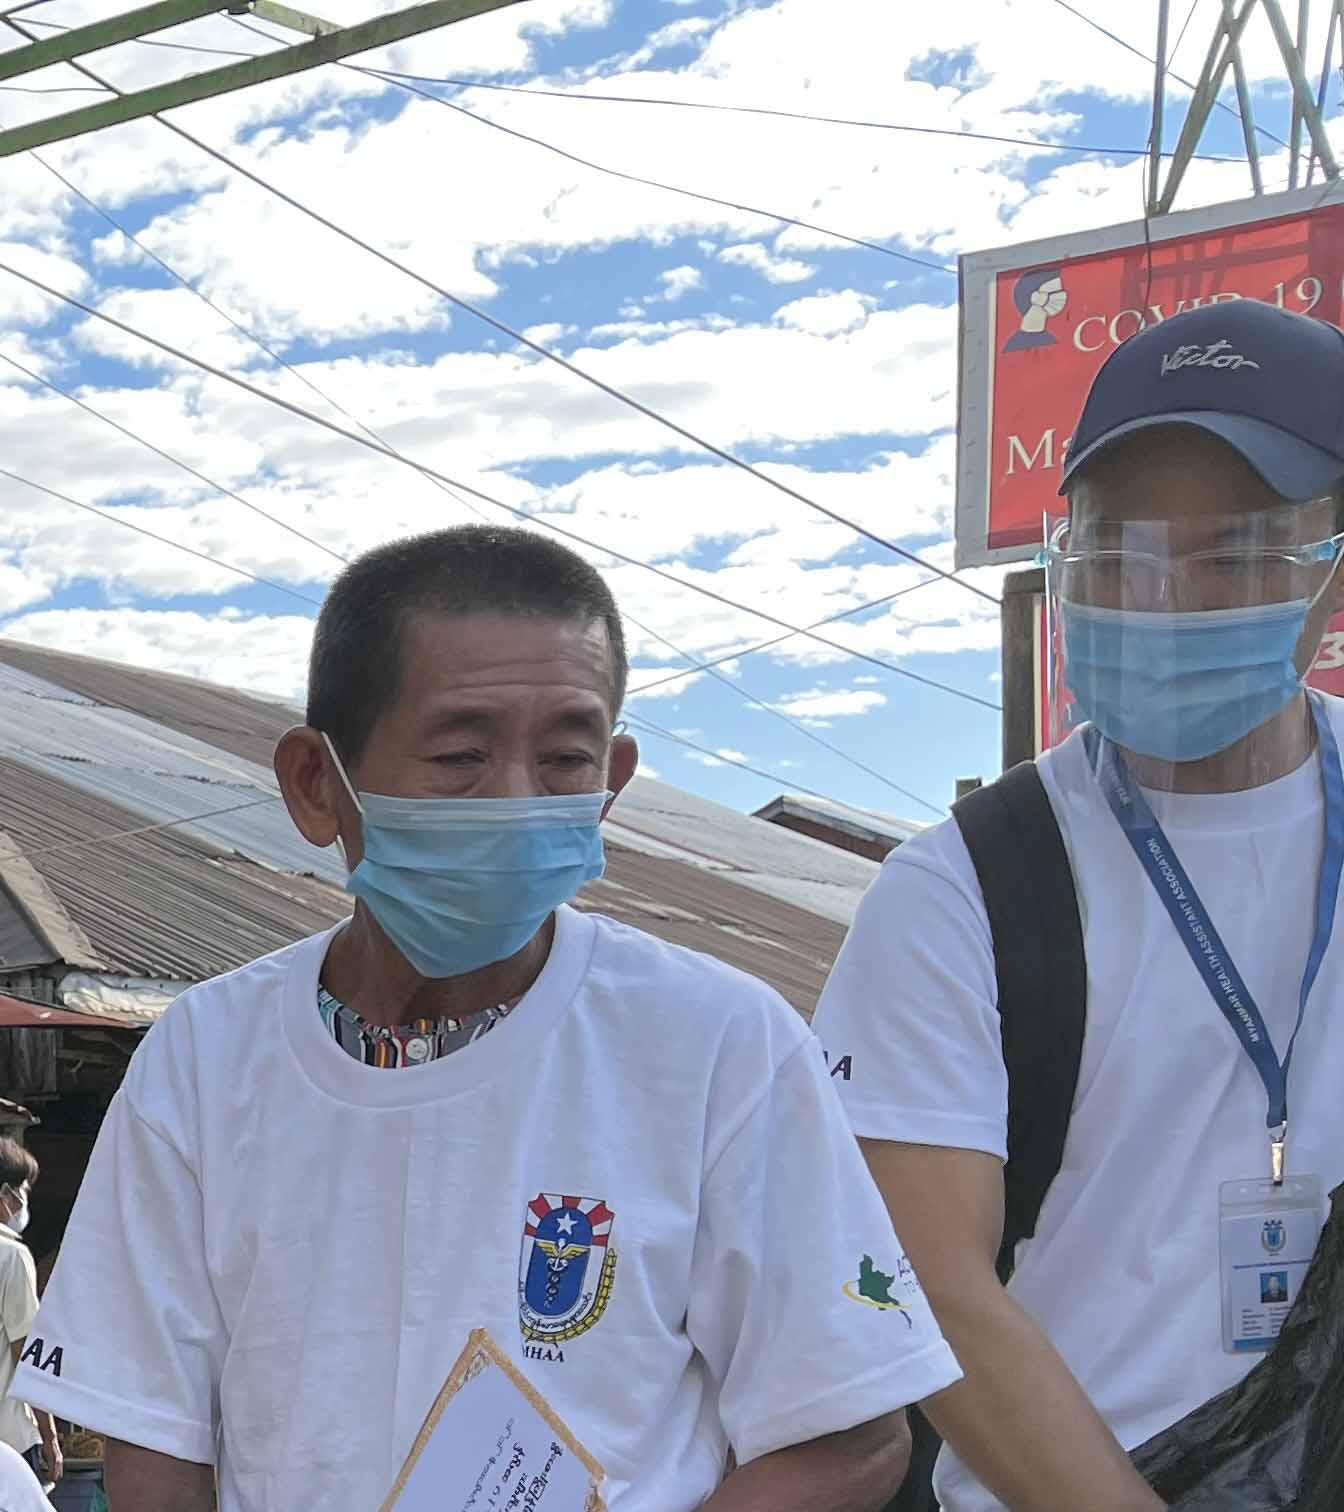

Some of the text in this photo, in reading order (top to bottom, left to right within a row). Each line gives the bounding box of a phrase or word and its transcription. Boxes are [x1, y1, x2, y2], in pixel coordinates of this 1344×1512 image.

[1146, 837, 1188, 901] ASSOCIATION
[1179, 899, 1214, 957] ASSISTANT
[1208, 951, 1234, 1000] HEALTH
